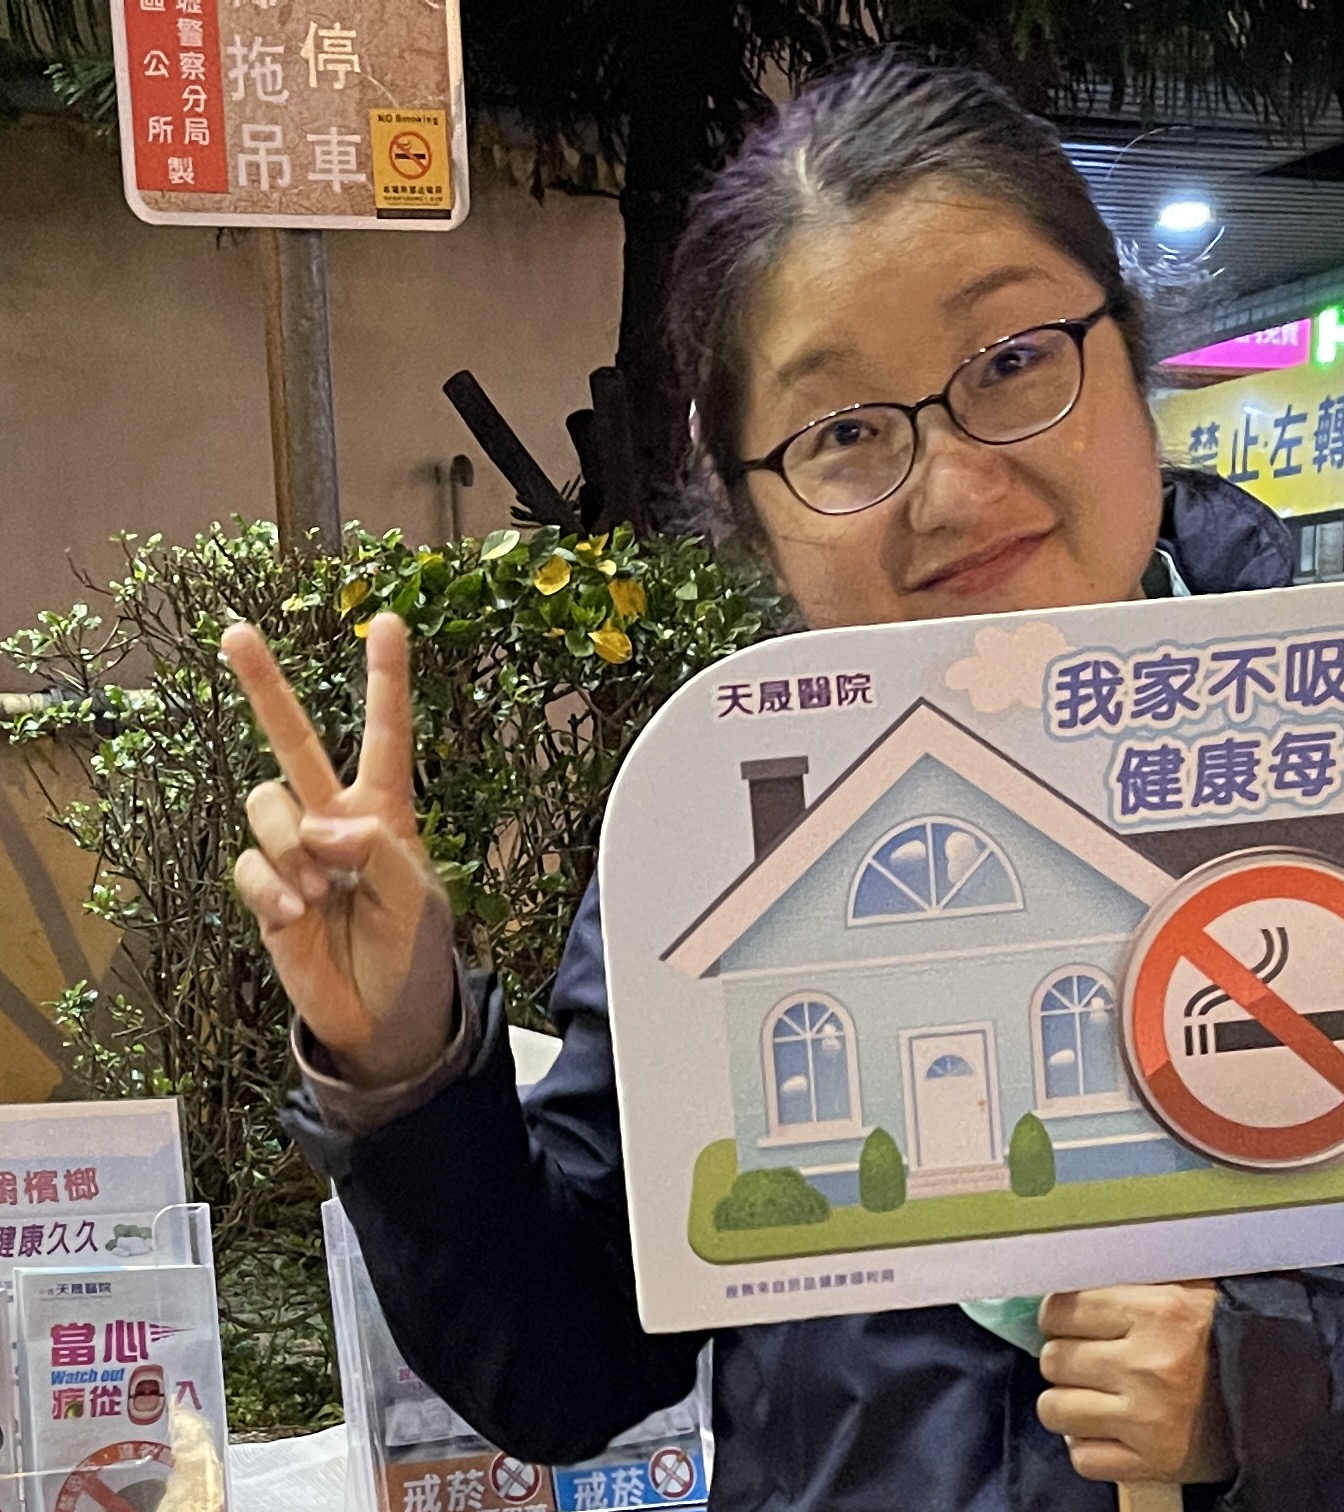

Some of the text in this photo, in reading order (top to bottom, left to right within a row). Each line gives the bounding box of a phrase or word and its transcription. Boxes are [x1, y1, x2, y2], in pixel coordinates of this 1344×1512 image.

[167, 157, 195, 185] 製
[716, 673, 875, 717] 天晟醫院
[50, 1320, 149, 1367] 當心
[52, 1367, 126, 1386] Watch out
[574, 1466, 646, 1511] 戒菸
